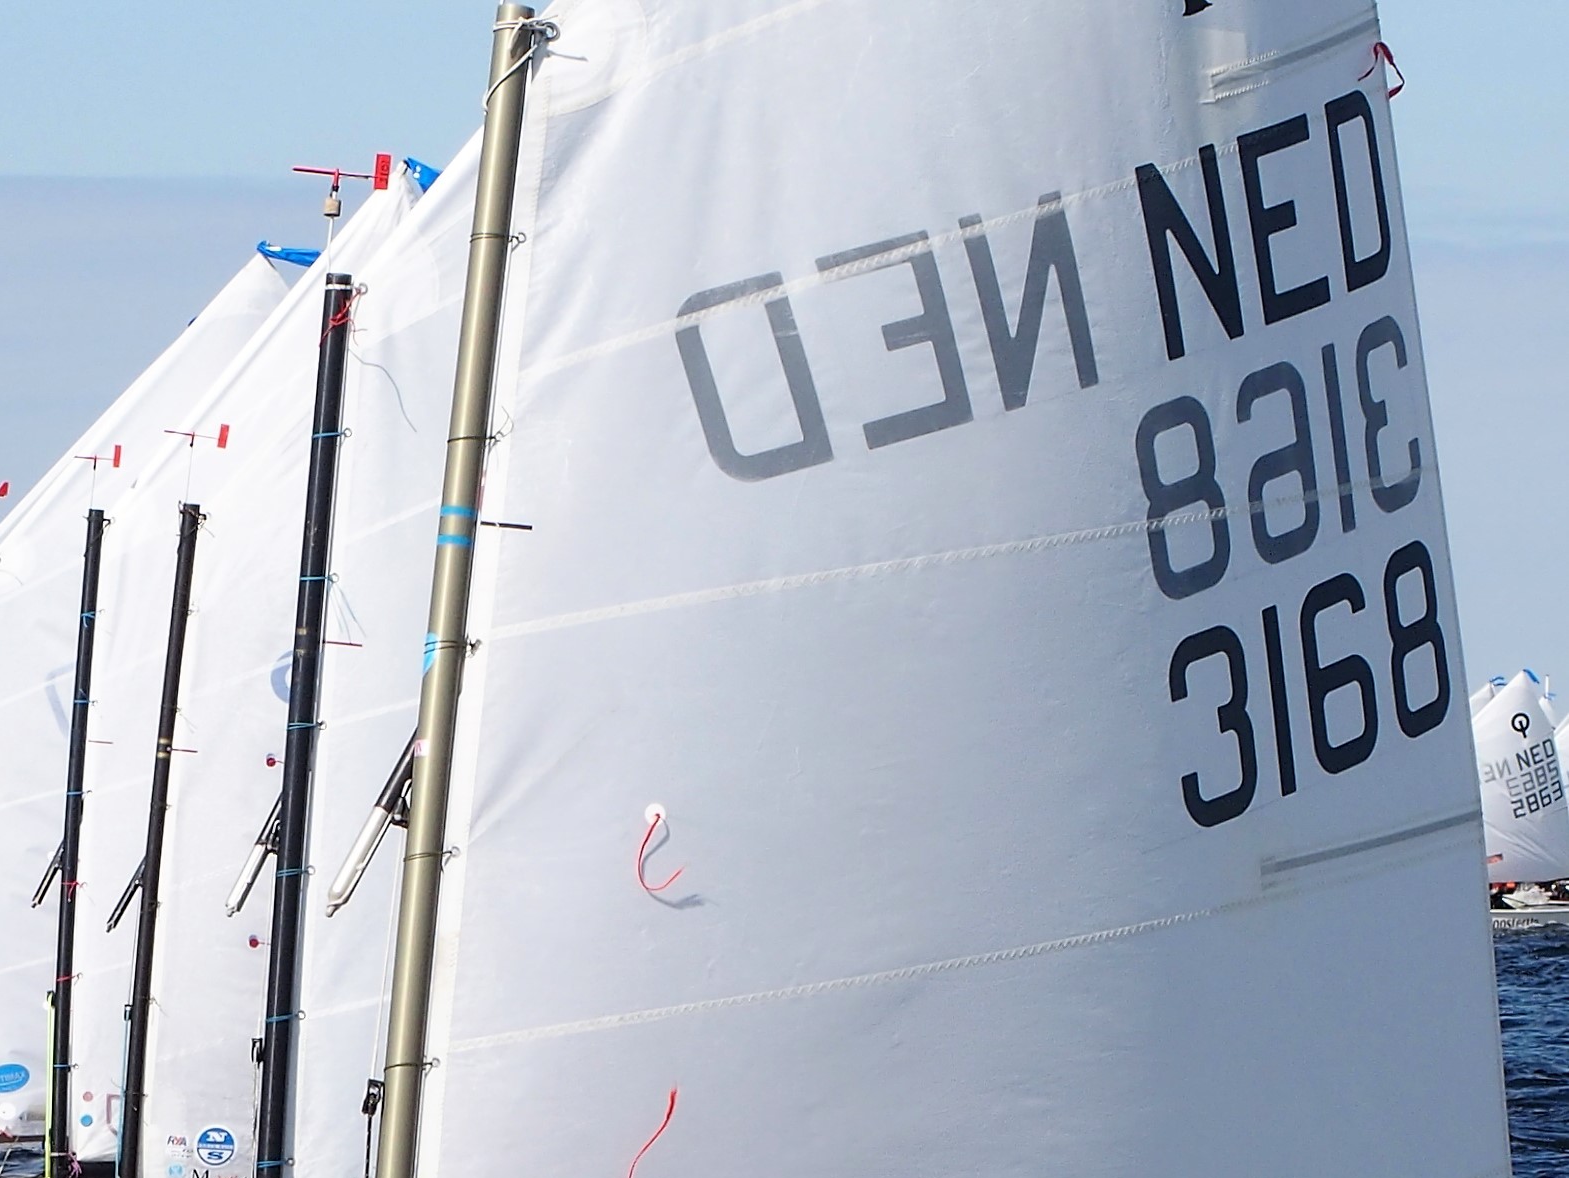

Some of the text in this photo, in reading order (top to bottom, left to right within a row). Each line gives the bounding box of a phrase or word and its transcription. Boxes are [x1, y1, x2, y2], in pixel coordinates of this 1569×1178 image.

[1135, 90, 1393, 361] NED
[1168, 540, 1450, 828] 3168
[1516, 739, 1555, 771] NED
[1511, 780, 1563, 819] 2863
